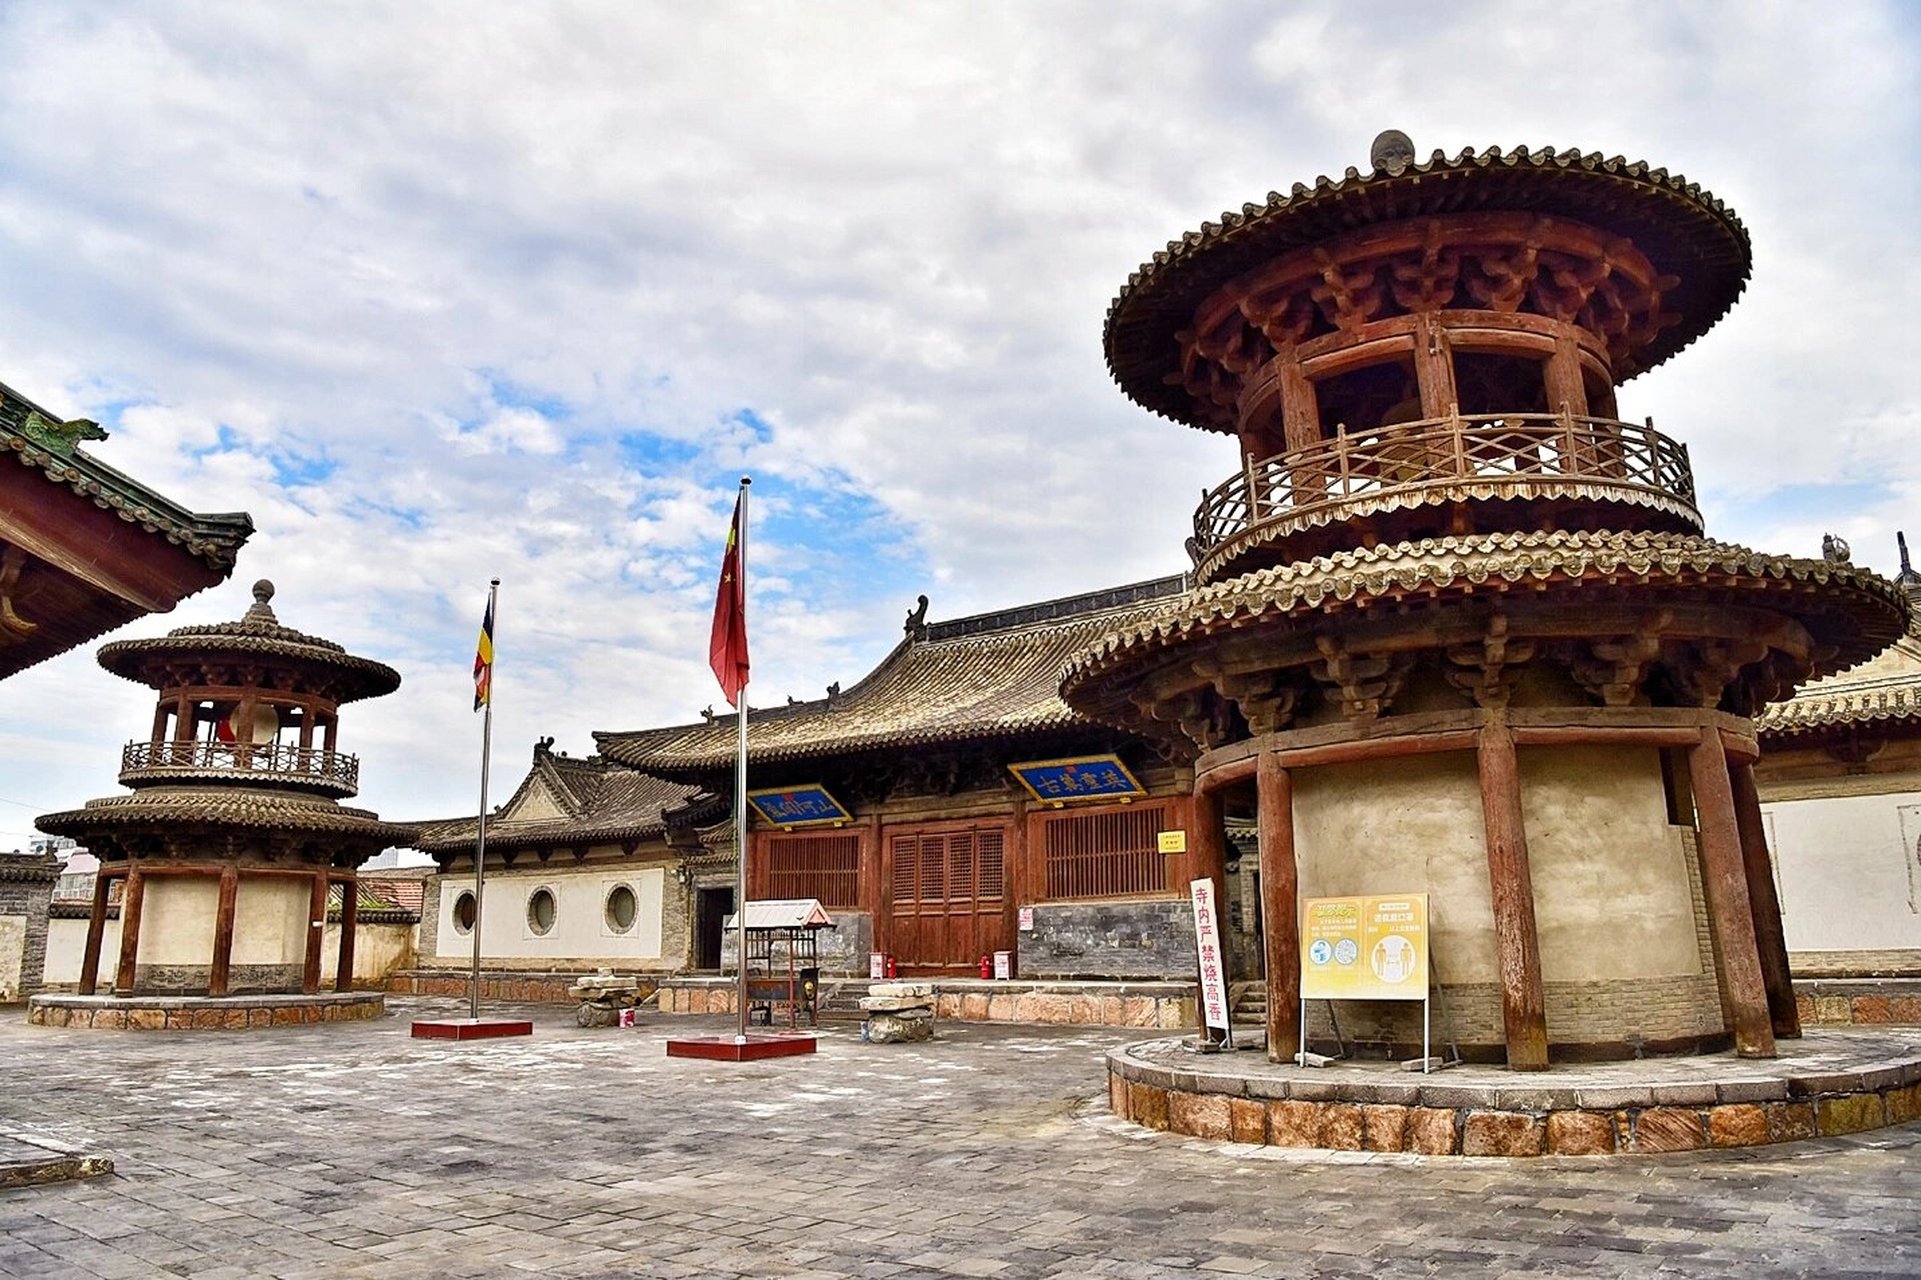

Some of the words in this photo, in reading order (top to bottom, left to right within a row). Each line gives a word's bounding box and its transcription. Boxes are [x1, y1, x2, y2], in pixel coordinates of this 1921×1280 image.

[1195, 886, 1221, 1021] 寺内严禁烧高香
